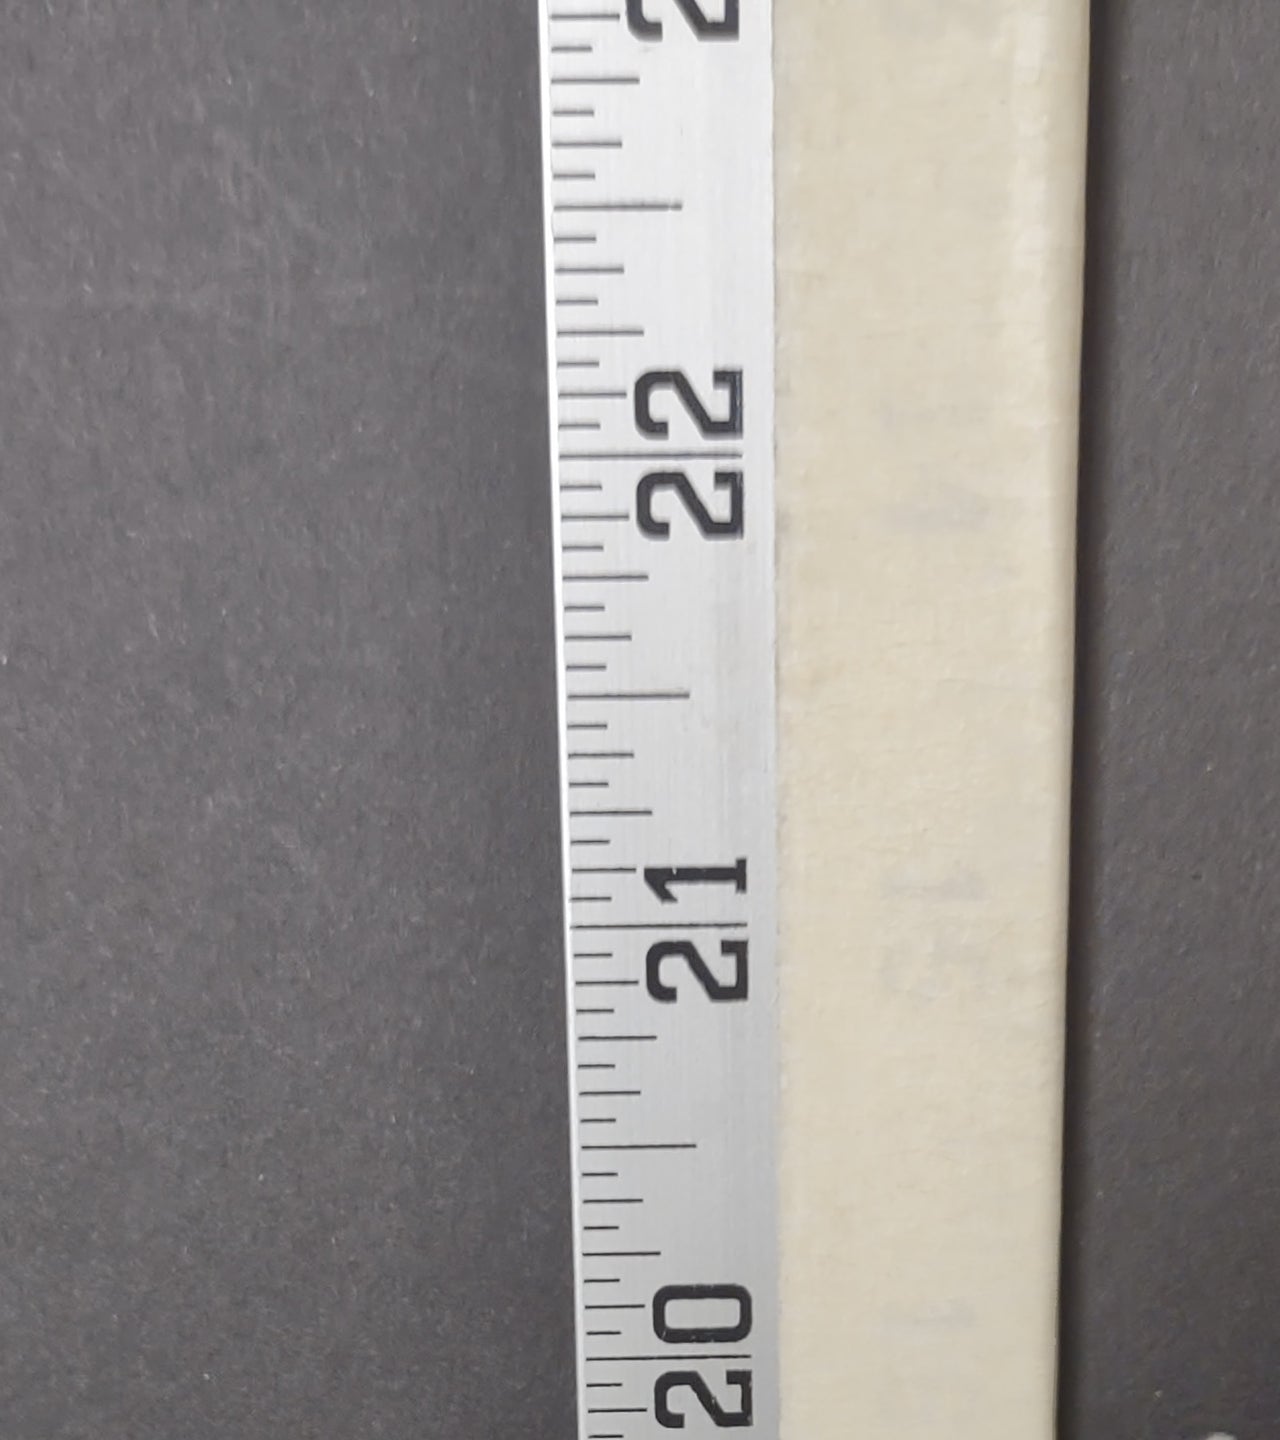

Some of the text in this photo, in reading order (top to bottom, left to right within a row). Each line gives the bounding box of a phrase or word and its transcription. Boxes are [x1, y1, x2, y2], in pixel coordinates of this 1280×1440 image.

[633, 368, 744, 541] 22
[642, 856, 750, 1005] 21
[651, 1282, 754, 1431] 20
